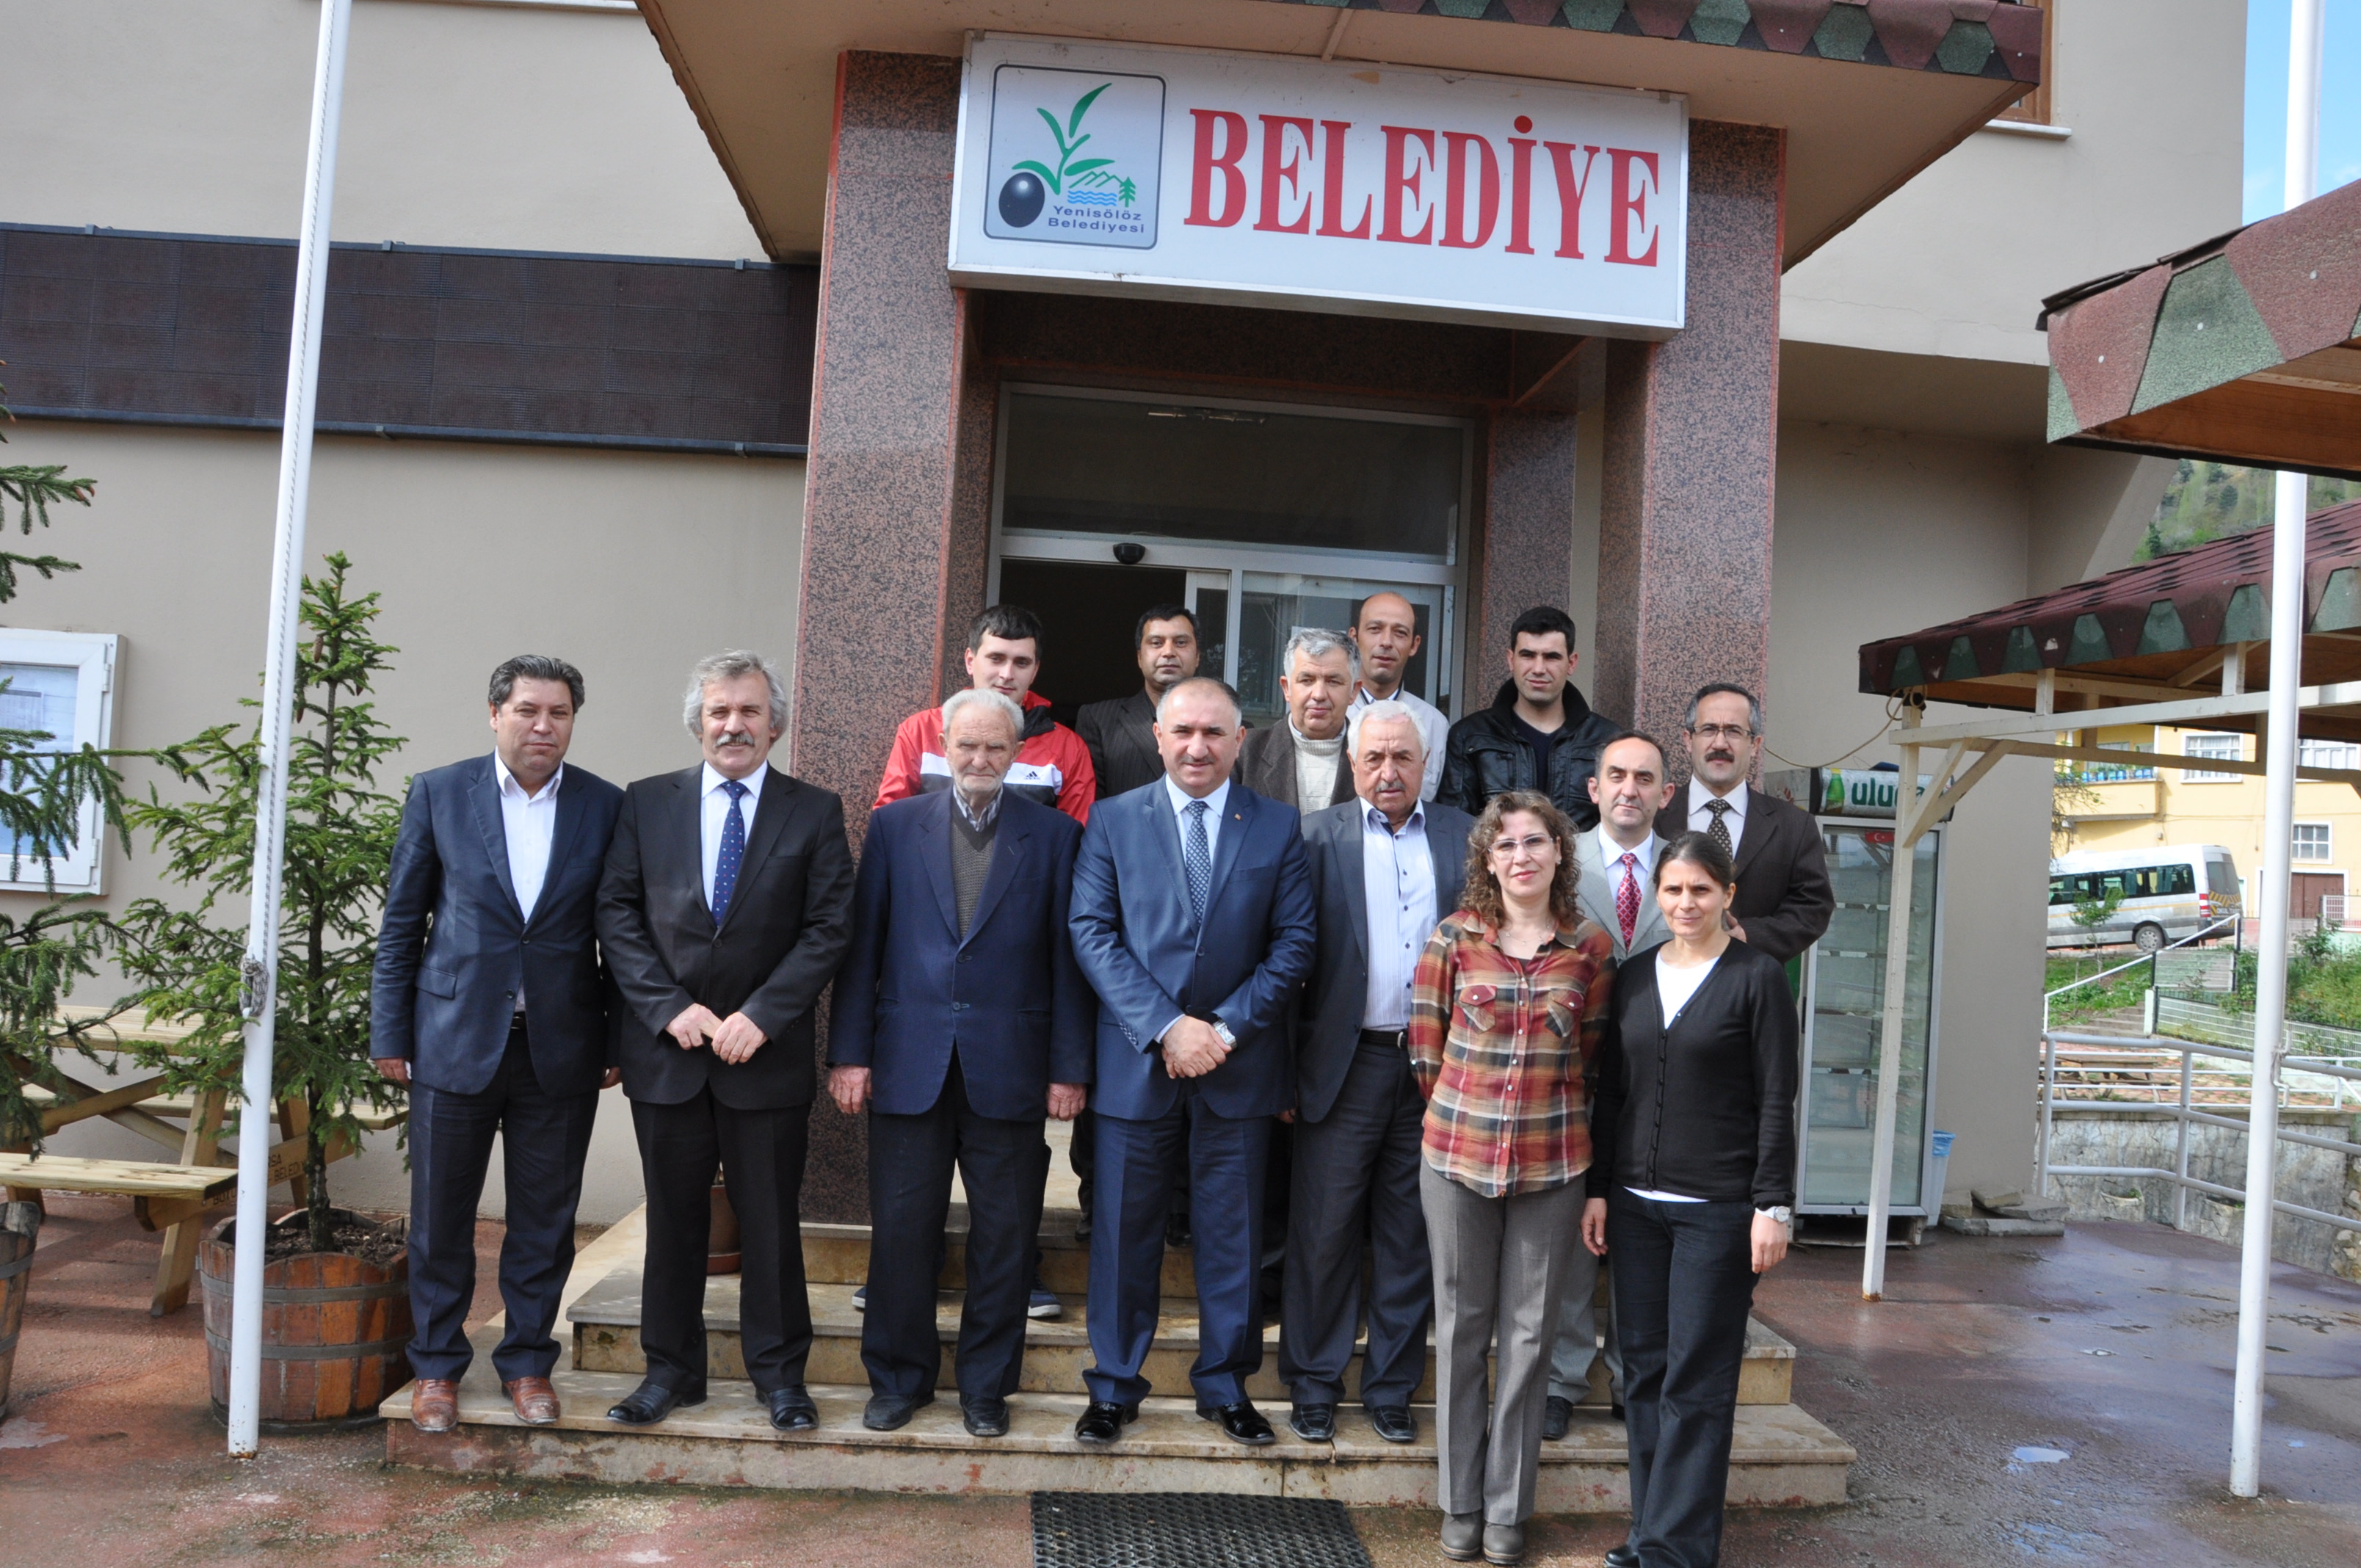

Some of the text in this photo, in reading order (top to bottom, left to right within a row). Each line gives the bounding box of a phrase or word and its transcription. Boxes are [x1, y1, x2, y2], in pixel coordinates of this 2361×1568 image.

[1183, 108, 1659, 267] BELEDİYE
[1053, 206, 1142, 221] Yenisölöz
[1048, 217, 1145, 233] Belediyesi
